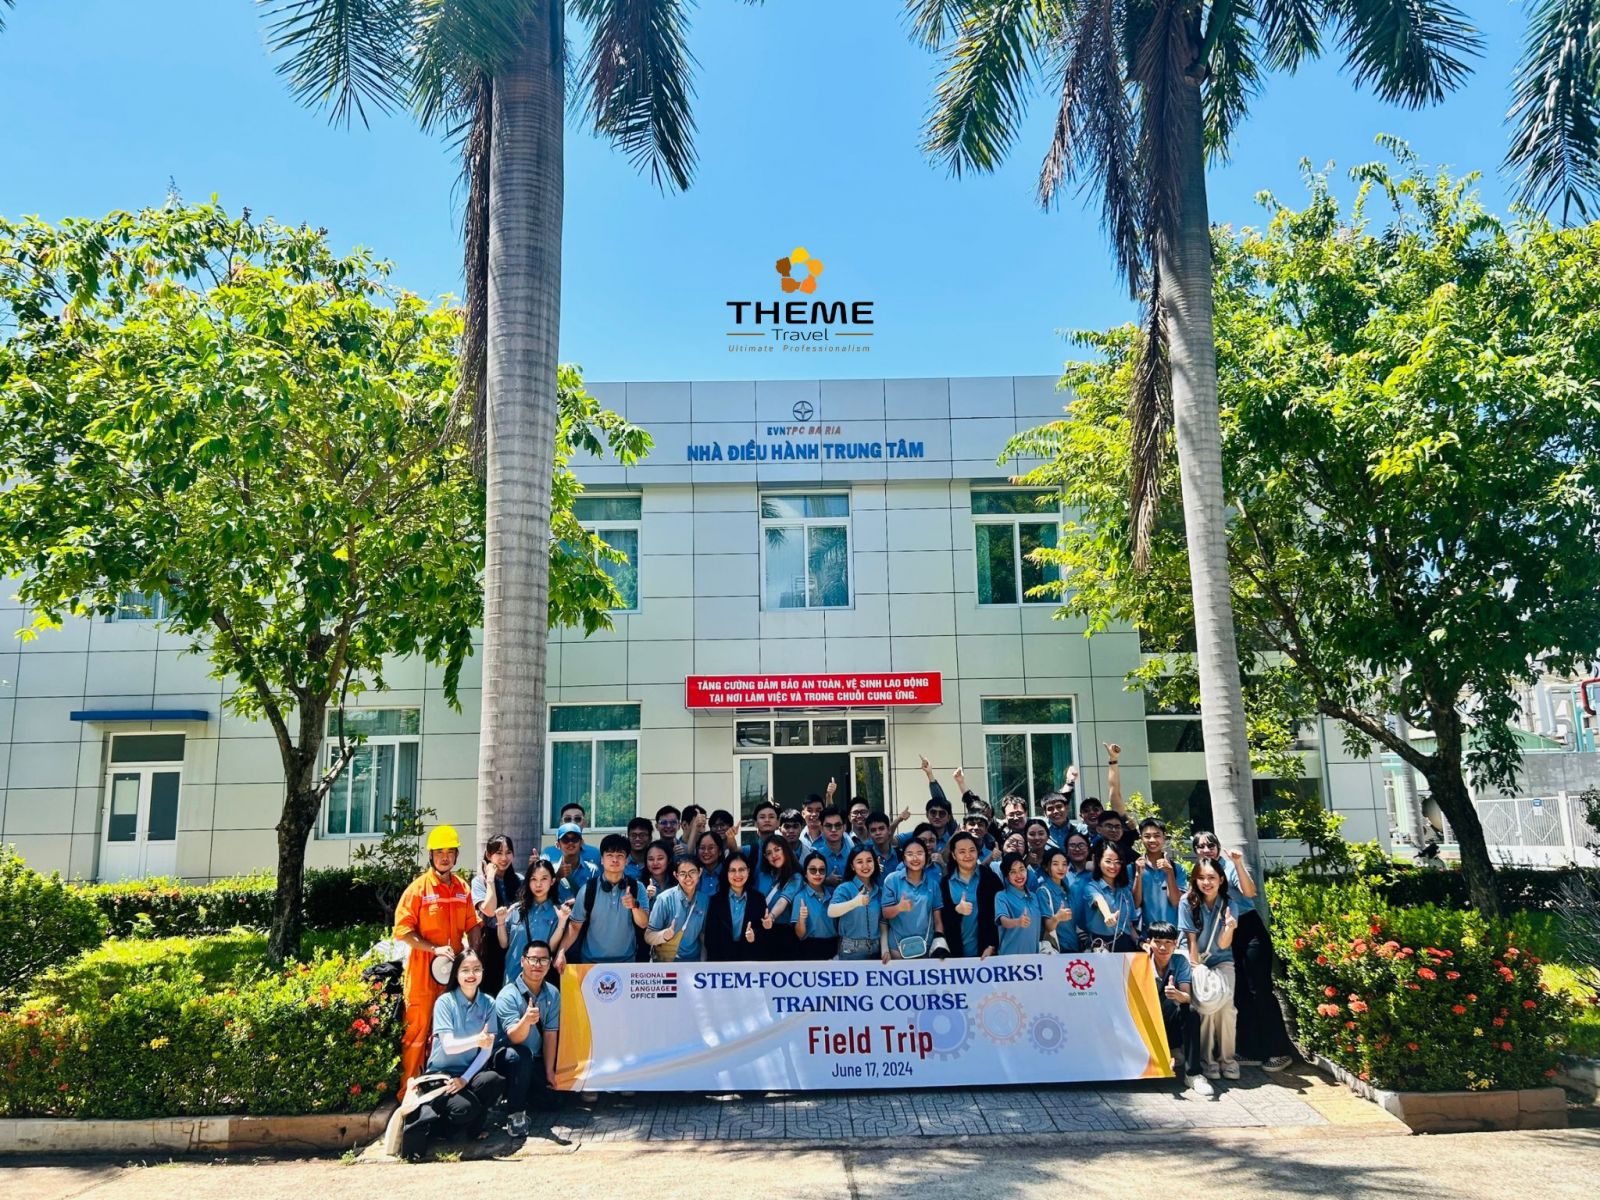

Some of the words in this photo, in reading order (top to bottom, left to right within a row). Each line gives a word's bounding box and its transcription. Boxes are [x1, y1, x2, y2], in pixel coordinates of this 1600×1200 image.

[687, 441, 723, 461] NHÀ
[727, 439, 767, 461] ĐIỀU
[771, 440, 819, 460] HÀNH
[823, 442, 882, 460] TRUNG
[886, 438, 924, 458] TÂM
[697, 680, 721, 691] TĂNG
[724, 679, 755, 690] CƯỜNG
[757, 678, 778, 690] ĐẢM
[781, 677, 799, 690] BẢO
[802, 680, 815, 690] AN
[846, 678, 857, 690] VỆ
[860, 679, 882, 689] SINH
[884, 679, 901, 688] LAO
[903, 677, 929, 689] ĐỘNG
[709, 693, 724, 704] TẠI
[726, 693, 742, 702] NƠI
[745, 692, 765, 702] LÀM
[767, 691, 787, 703] VIỆC
[790, 691, 802, 702] VÀ
[804, 692, 834, 702] TRONG
[867, 691, 892, 701] CUNG
[895, 689, 918, 700] ỨNG.
[693, 971, 859, 989] STEM-FOCUSED
[866, 964, 1044, 987] ENGLISHWORKS!
[772, 995, 874, 1013] TRAINING
[880, 993, 969, 1011] COURSE
[808, 1026, 871, 1055] Field
[880, 1024, 933, 1060] Trip
[832, 1063, 862, 1077] June
[865, 1063, 879, 1078] 17,
[882, 1061, 913, 1077] 2024
